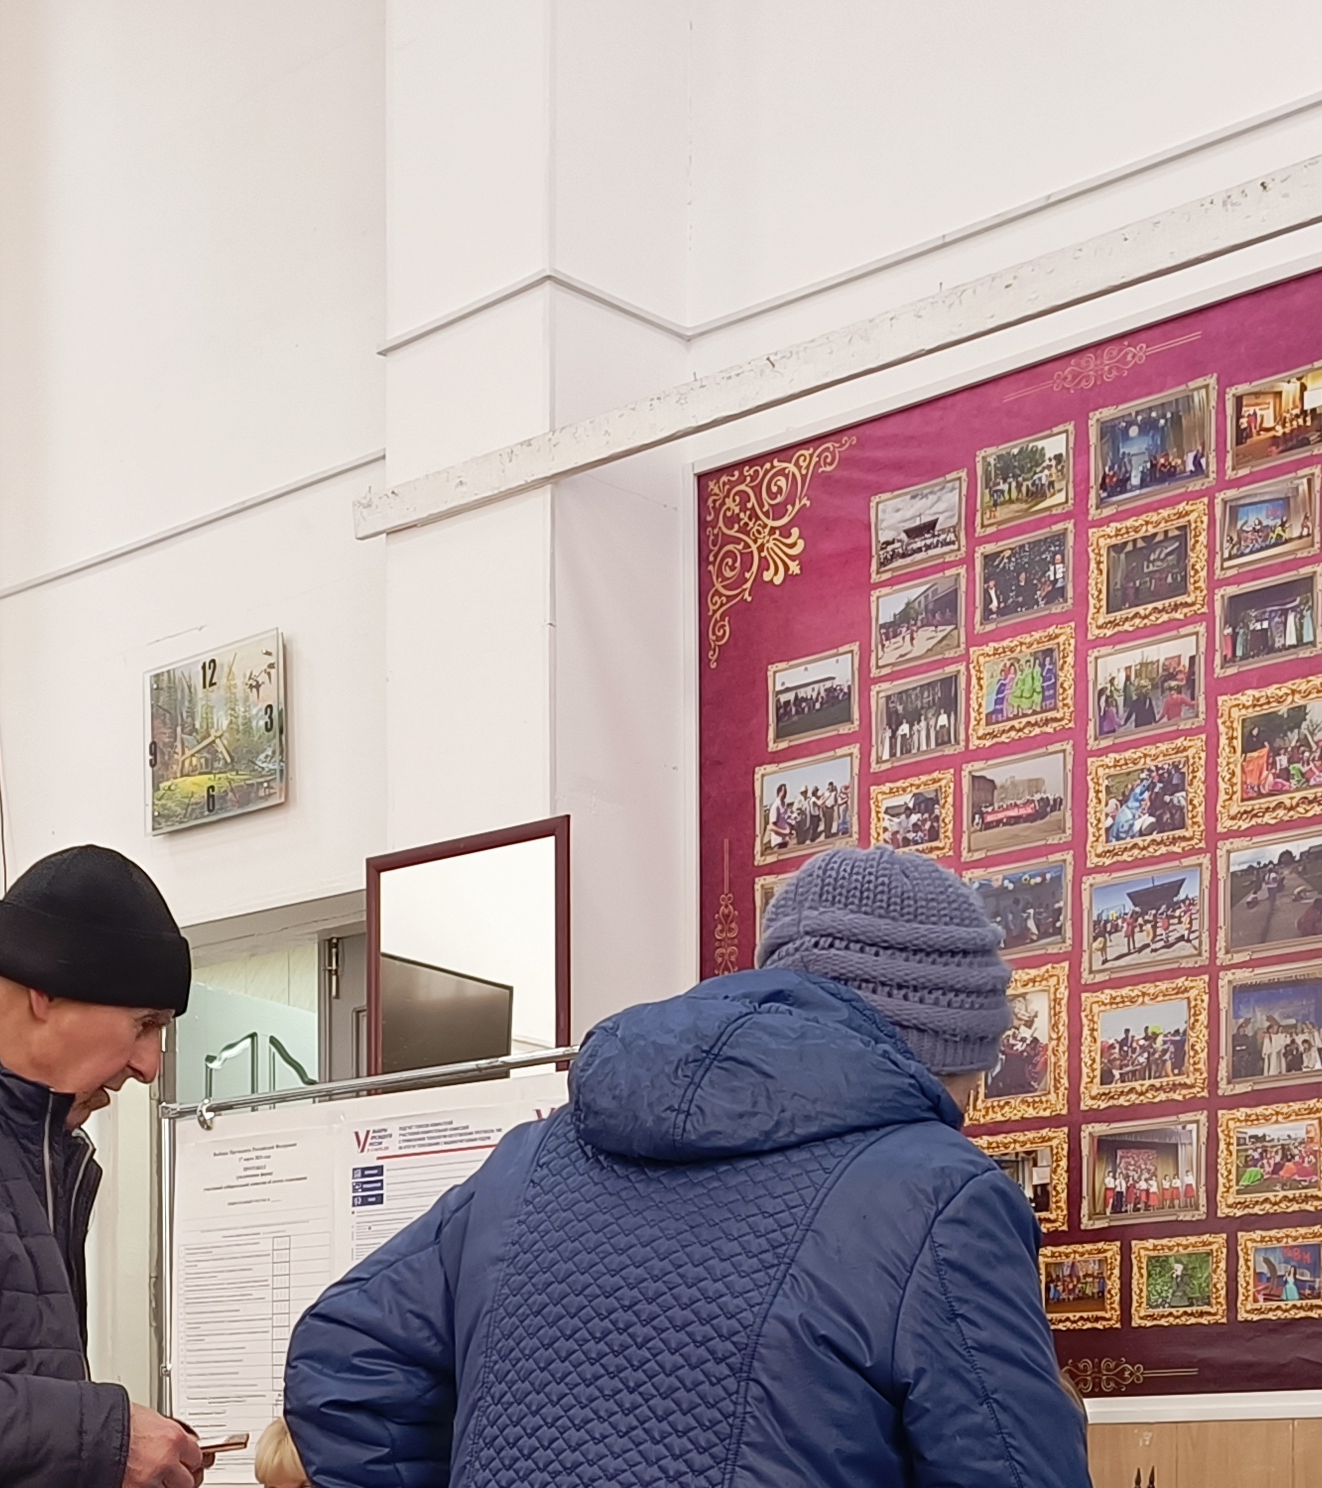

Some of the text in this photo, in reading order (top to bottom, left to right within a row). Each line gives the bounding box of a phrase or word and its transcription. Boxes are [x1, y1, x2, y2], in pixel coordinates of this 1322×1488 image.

[201, 658, 217, 689] 12
[264, 703, 274, 733] 3
[149, 740, 158, 768] 9
[206, 785, 216, 813] 6
